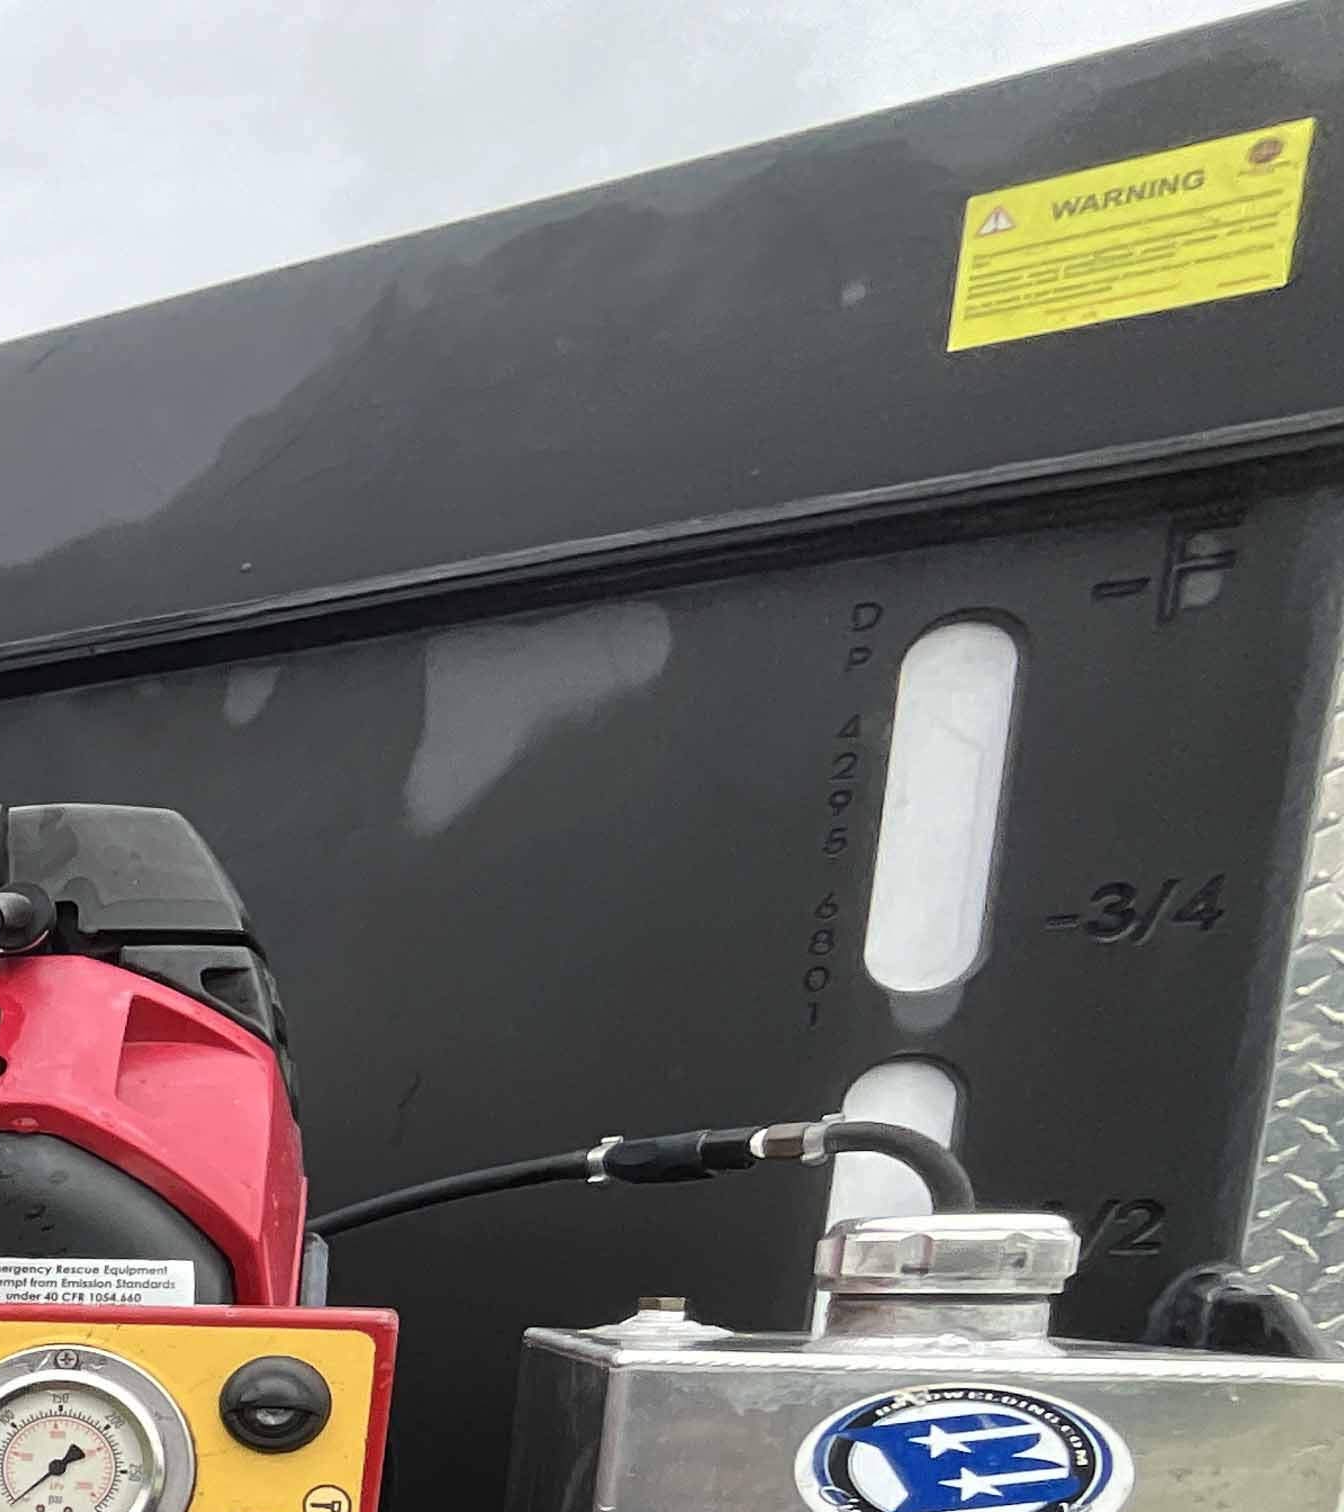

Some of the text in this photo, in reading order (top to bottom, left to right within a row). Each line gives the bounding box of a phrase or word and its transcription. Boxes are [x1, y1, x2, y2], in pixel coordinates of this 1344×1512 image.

[1051, 168, 1206, 220] WARNING
[56, 1264, 99, 1274] Rescue
[103, 1265, 168, 1277] Equipment
[30, 1278, 57, 1288] from
[61, 1278, 112, 1289] Emission
[116, 1278, 176, 1290] Standards
[6, 1291, 41, 1302] under
[44, 1291, 58, 1302] 40
[62, 1291, 84, 1302] CFR
